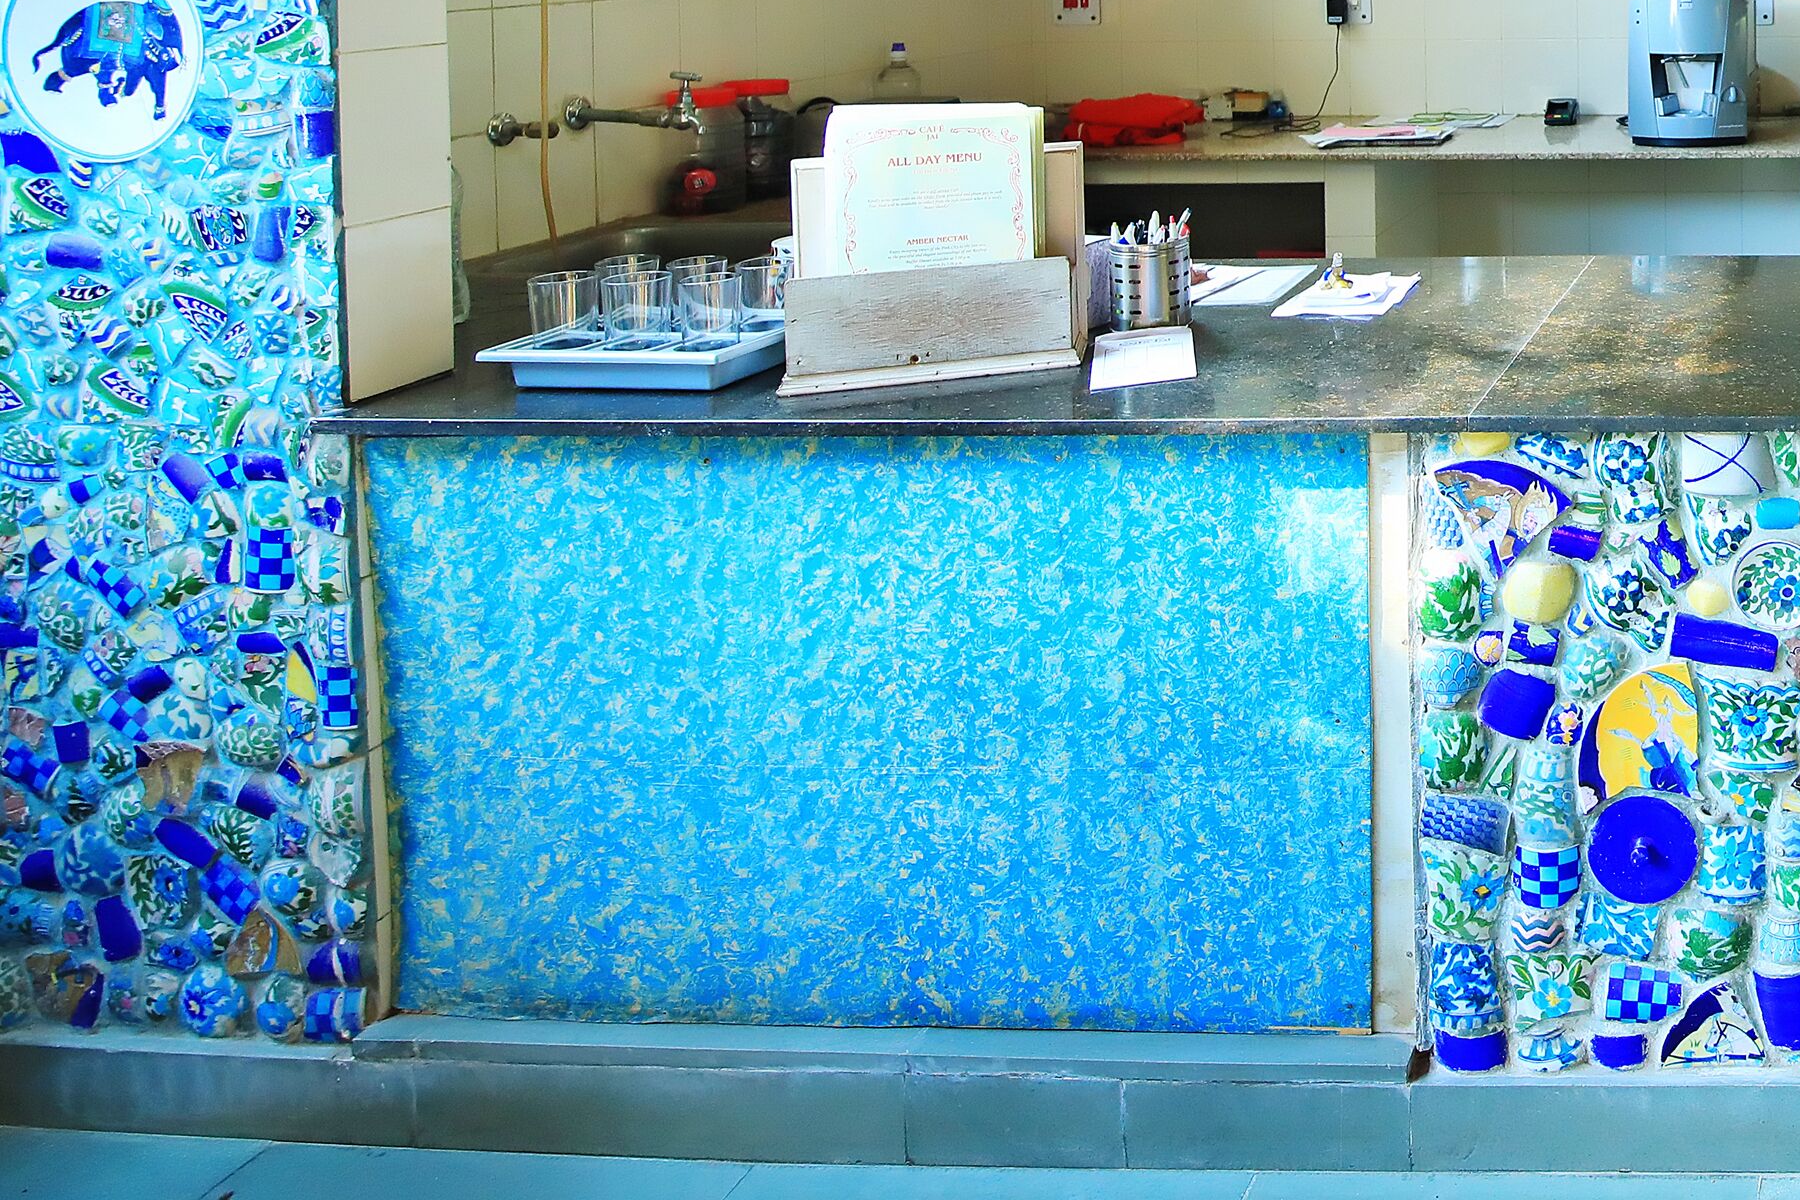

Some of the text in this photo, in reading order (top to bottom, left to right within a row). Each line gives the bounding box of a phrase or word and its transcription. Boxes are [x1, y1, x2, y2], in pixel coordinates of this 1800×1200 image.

[887, 152, 983, 168] ALL DAY MENU
[906, 234, 969, 246] AMBER NECTAR
